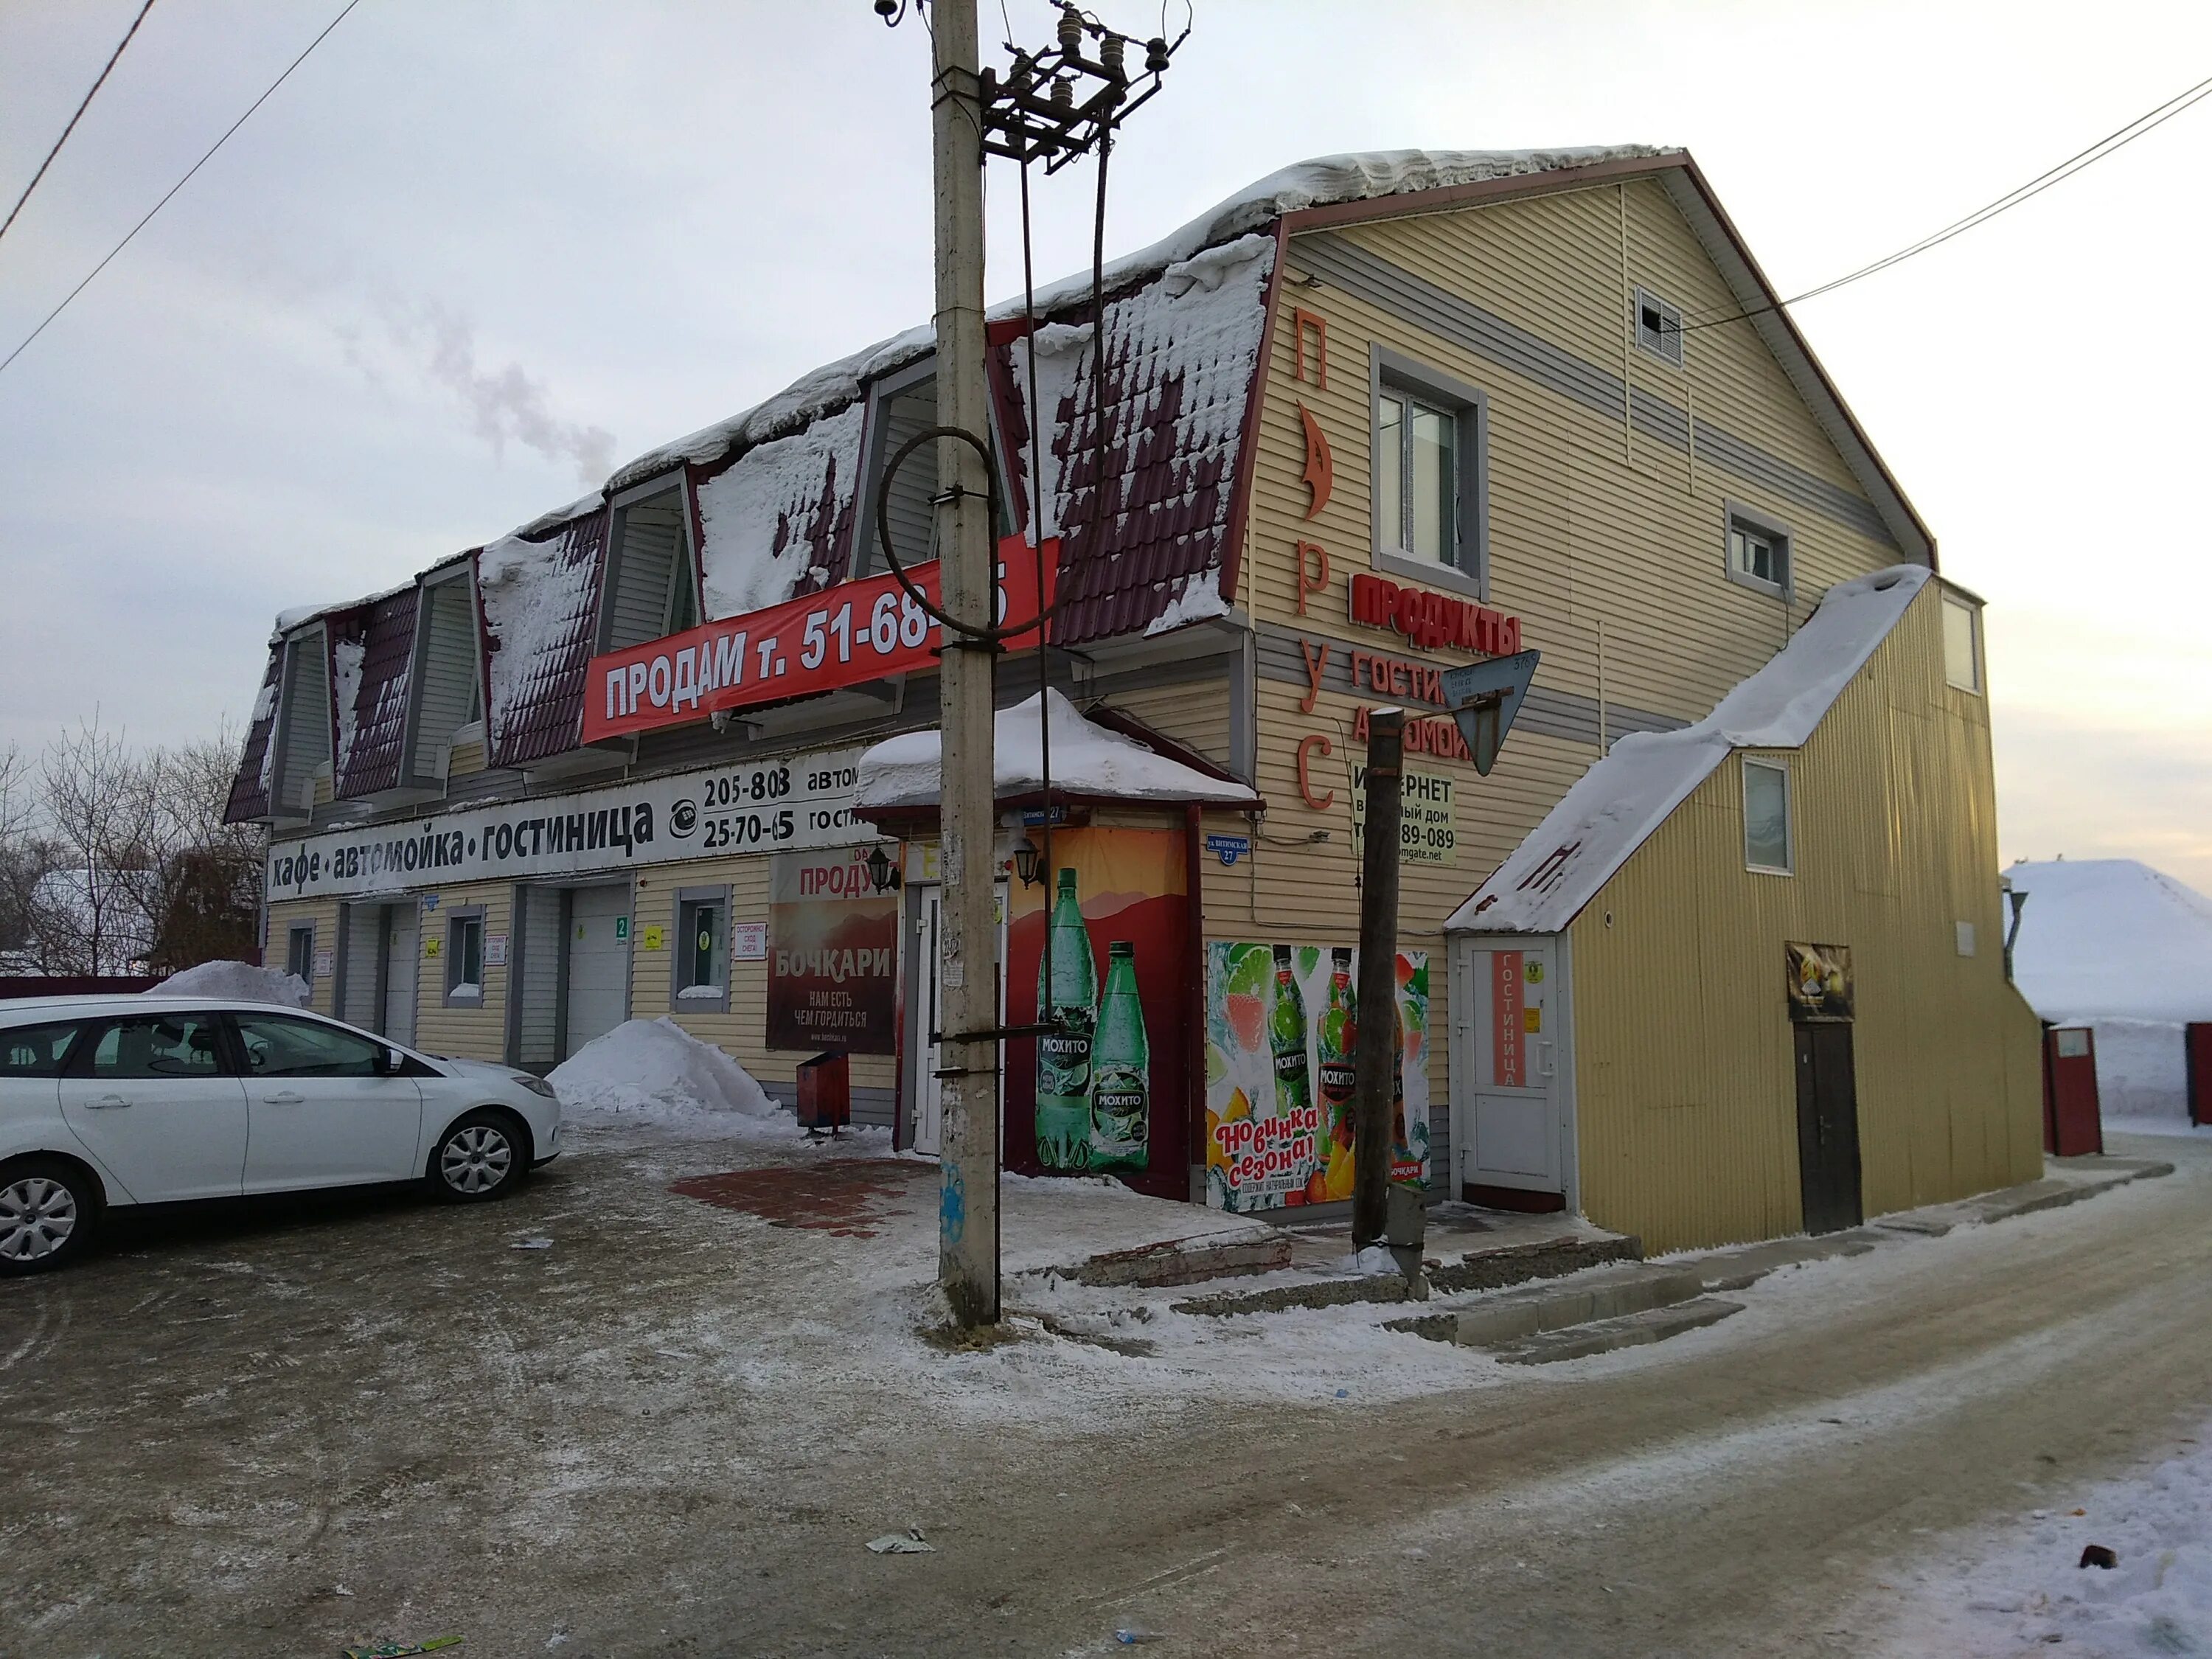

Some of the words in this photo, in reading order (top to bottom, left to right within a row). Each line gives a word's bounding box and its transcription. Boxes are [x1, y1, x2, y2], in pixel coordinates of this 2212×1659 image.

[1350, 574, 1521, 656] ПРОДУКТЫ
[606, 631, 747, 720] ПРОДАМ
[757, 637, 786, 679] т.
[1050, 806, 1060, 818] 27
[1425, 810, 1449, 824] дом
[333, 823, 464, 880] автомойка
[481, 802, 654, 861] гостиница
[1402, 824, 1454, 849] 89-089
[1224, 850, 1234, 860] 27
[618, 919, 625, 935] 2
[776, 947, 890, 983] БОЧКАРИ
[810, 991, 830, 1007] НАМ
[831, 992, 852, 1007] ЕСТЬ
[794, 1009, 813, 1026] ЧЕМ
[815, 1011, 867, 1028] ГОРДИТЬСЯ
[1502, 954, 1516, 1086] ГОСТИНИЦА
[1042, 1037, 1088, 1054] МОХИТО
[1275, 1053, 1307, 1070] МОХИТО
[1320, 1070, 1355, 1085] МОХИТО
[1098, 1095, 1141, 1106] МОХИТО
[1217, 1107, 1318, 1155] Новинка
[1230, 1136, 1314, 1187] сезона!
